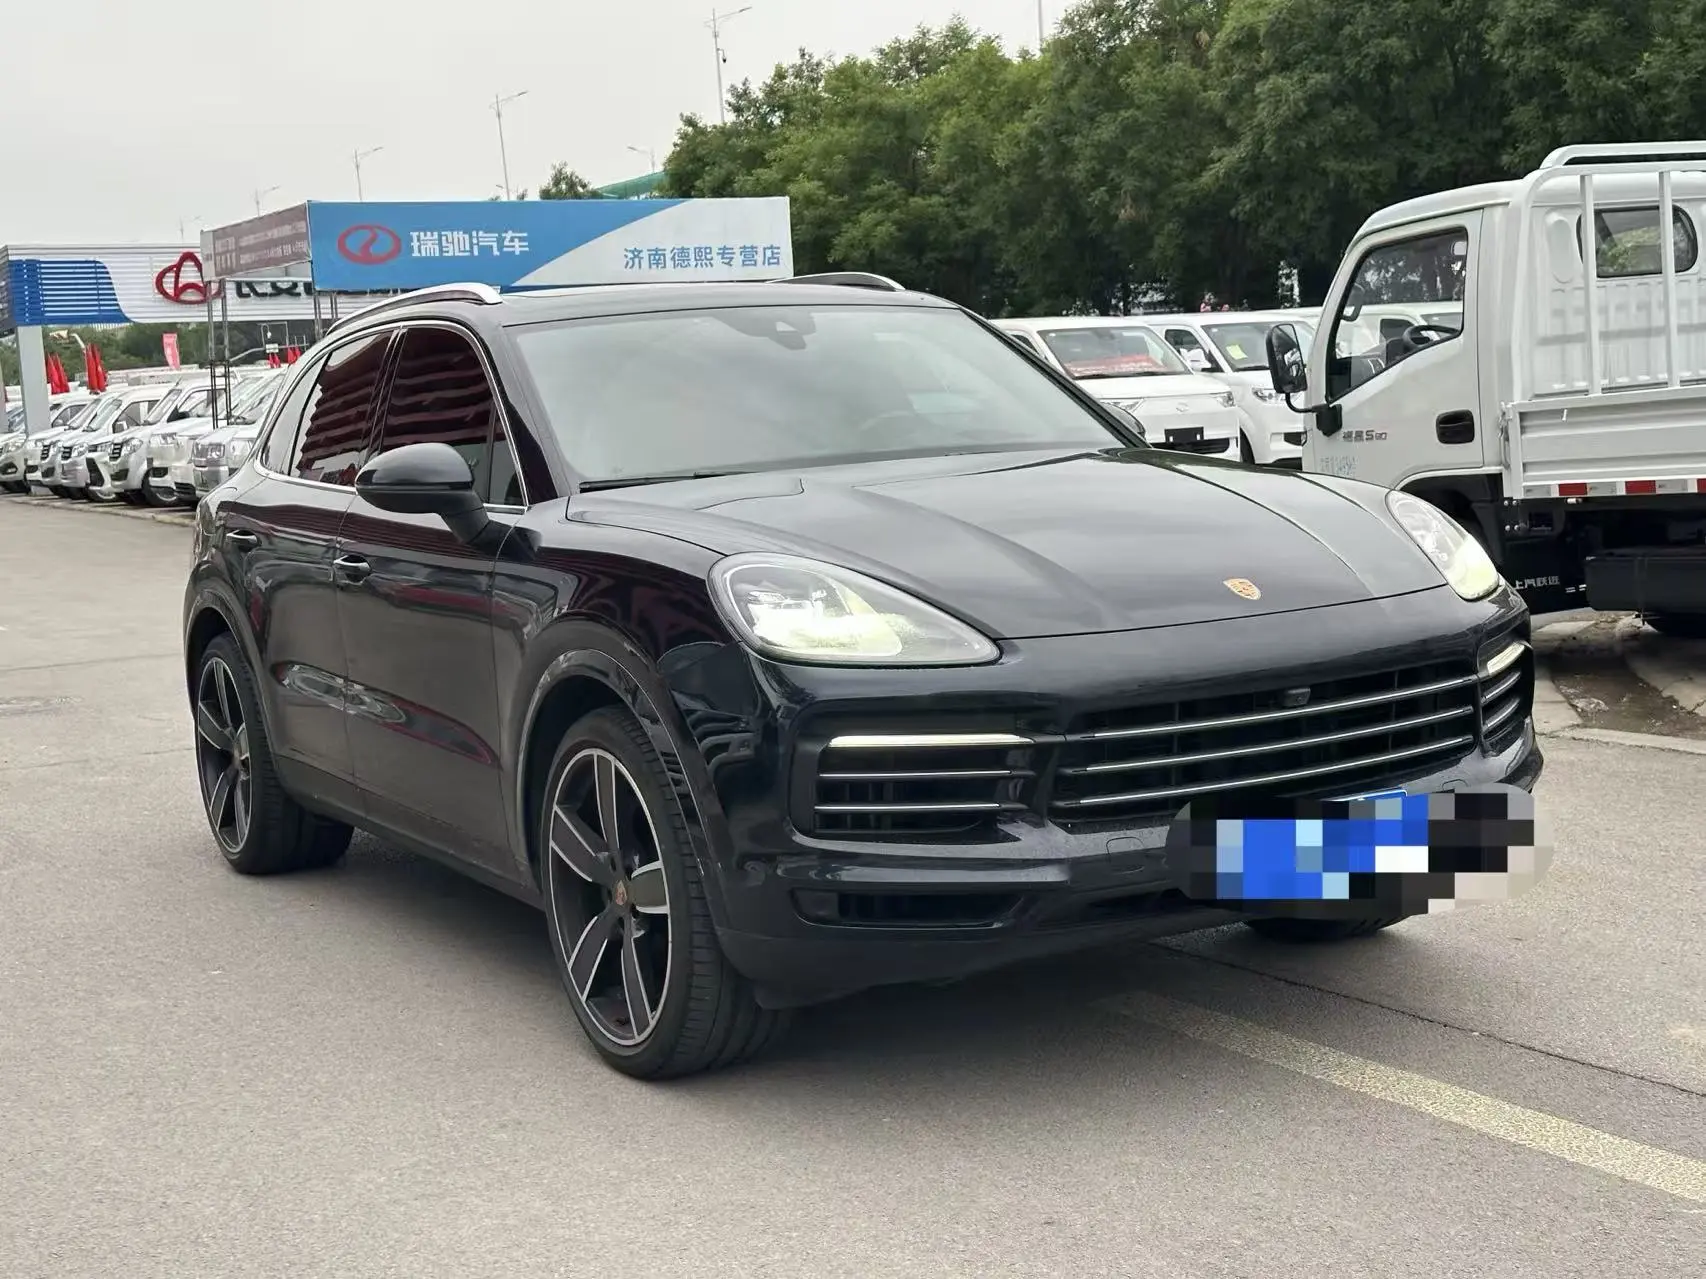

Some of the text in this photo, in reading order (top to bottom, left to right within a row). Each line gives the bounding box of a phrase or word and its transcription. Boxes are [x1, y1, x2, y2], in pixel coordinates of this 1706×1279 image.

[410, 230, 530, 257] 瑞驰汽车
[623, 245, 781, 270] 济南德熙专营店
